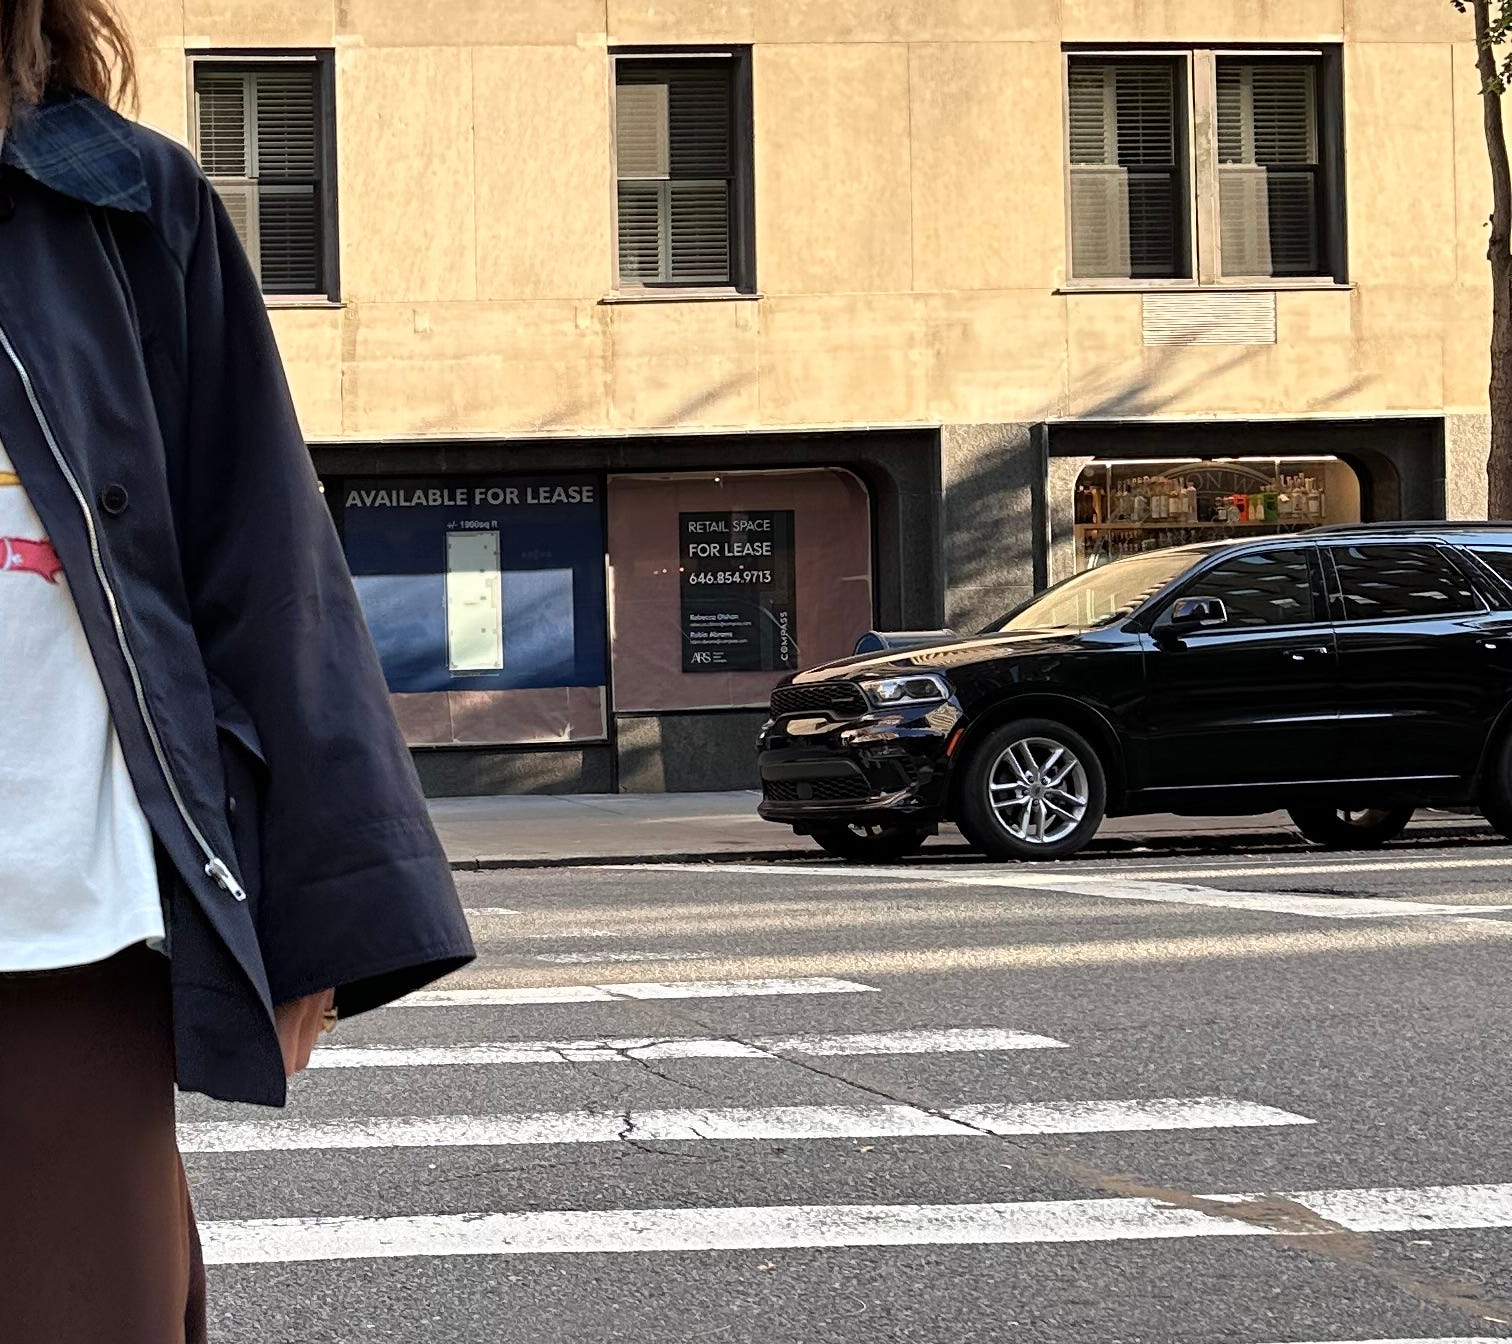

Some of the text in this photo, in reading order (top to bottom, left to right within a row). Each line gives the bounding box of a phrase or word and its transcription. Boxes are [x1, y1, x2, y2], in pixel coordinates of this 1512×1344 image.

[345, 486, 594, 507] AVAILABLE FOR LEASE
[688, 520, 771, 533] RETAIL SPACE
[689, 542, 772, 557] FOR LEASE
[689, 570, 772, 585] 646.854.9713
[780, 612, 788, 661] COMPASS
